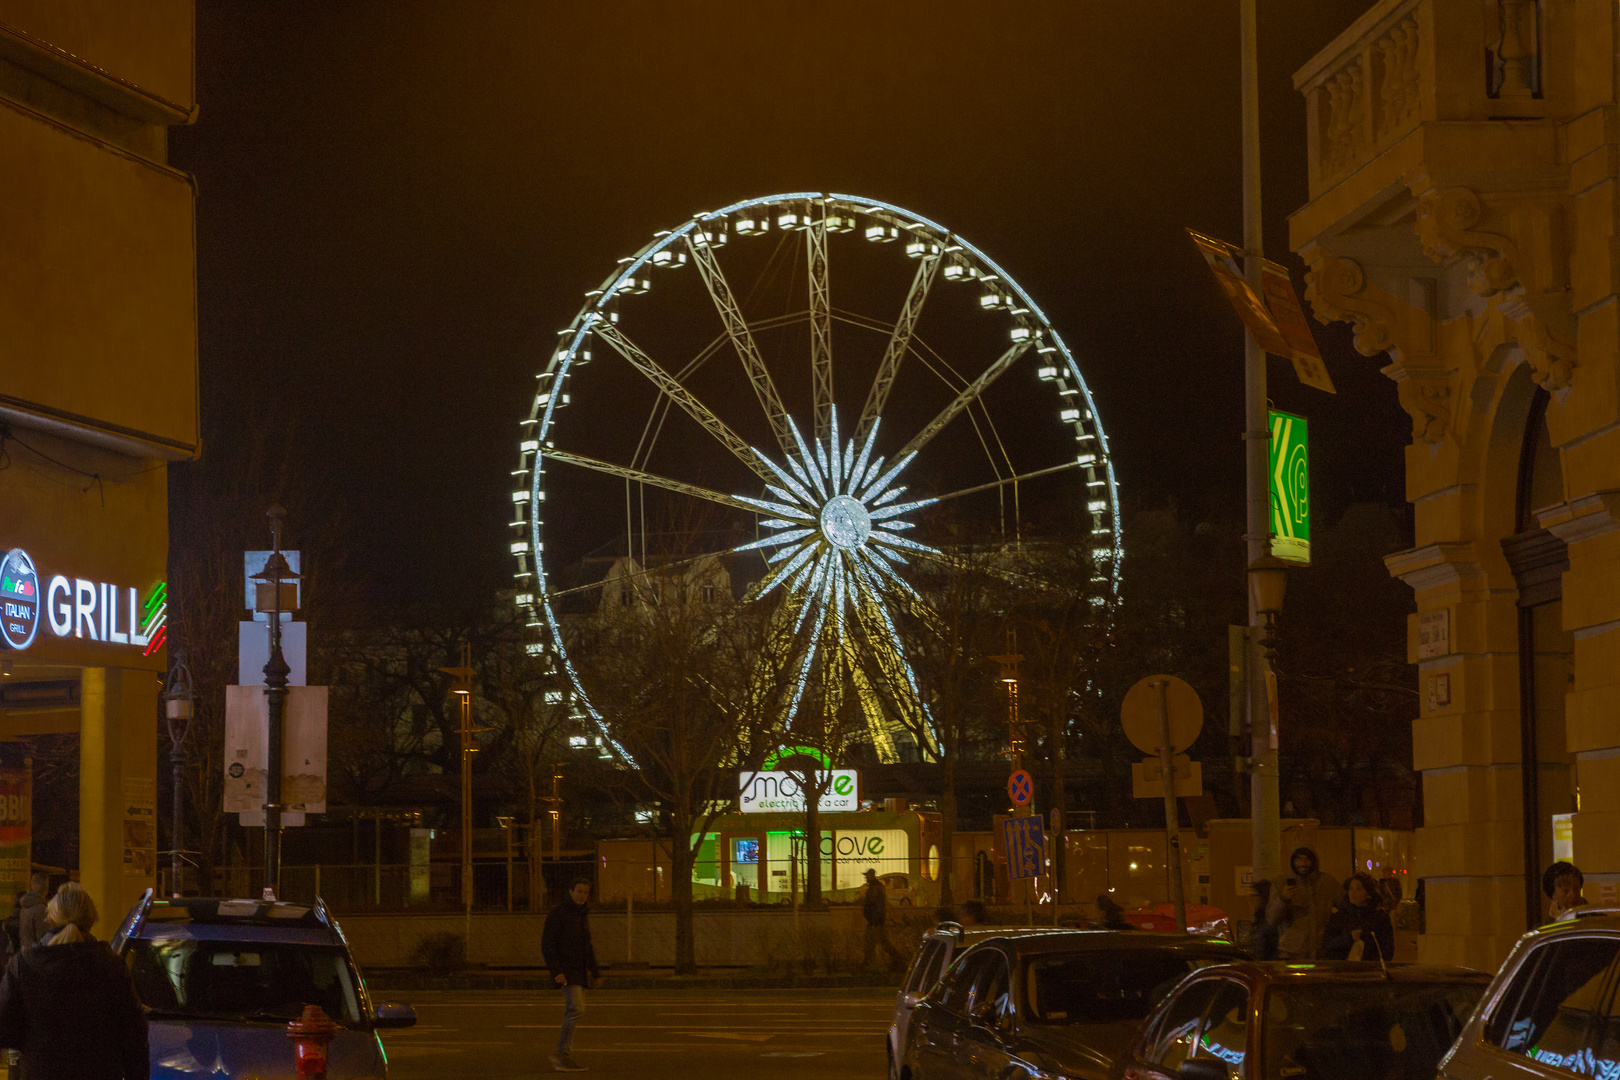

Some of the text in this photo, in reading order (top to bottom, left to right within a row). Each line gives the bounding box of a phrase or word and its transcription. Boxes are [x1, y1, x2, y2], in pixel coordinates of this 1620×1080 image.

[5, 602, 31, 620] ITALIAN
[47, 575, 148, 646] GRILL
[9, 622, 26, 635] GRILL
[749, 775, 854, 799] moe
[833, 799, 849, 807] car
[819, 836, 885, 855] oove
